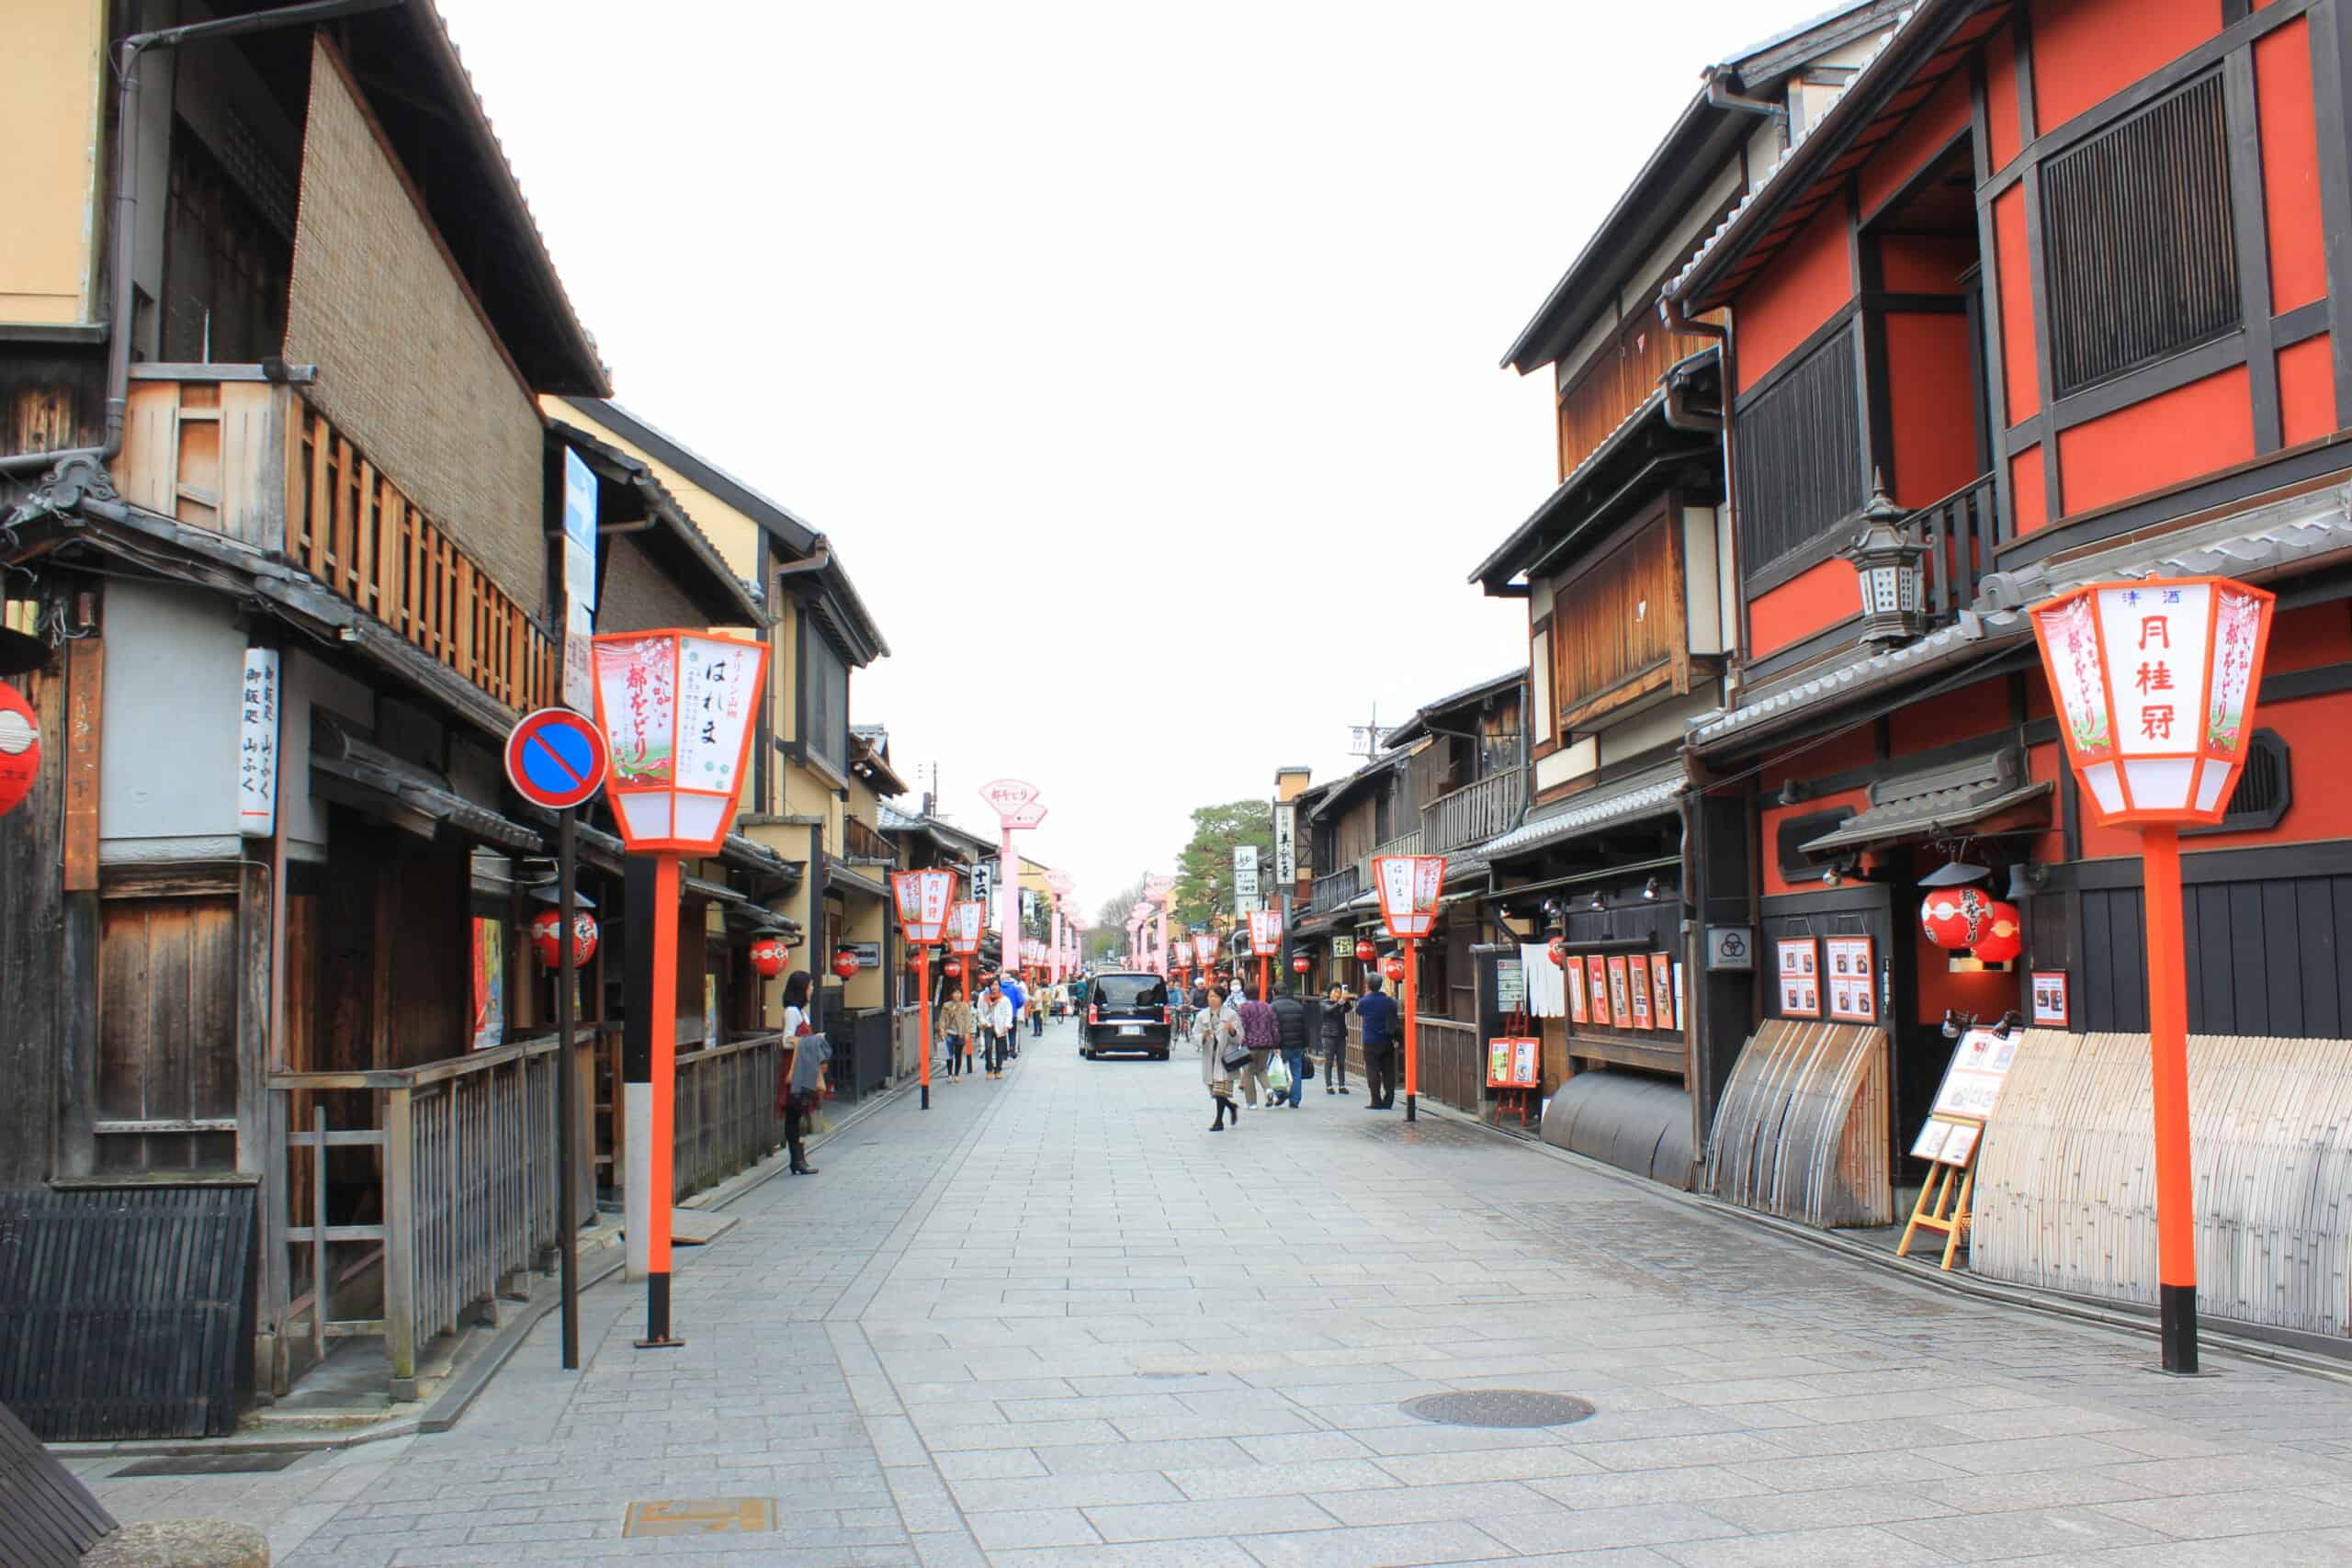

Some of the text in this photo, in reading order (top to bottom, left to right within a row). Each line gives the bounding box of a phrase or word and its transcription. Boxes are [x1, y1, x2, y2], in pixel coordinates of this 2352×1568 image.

[2121, 589, 2182, 608] 清酒
[626, 661, 649, 764] 都をどり
[701, 658, 727, 745] はれま
[2067, 628, 2096, 736] 都をどり
[2134, 614, 2176, 740] 月桂冠
[2212, 616, 2240, 728] 都をどり
[242, 737, 258, 793] 山ふく
